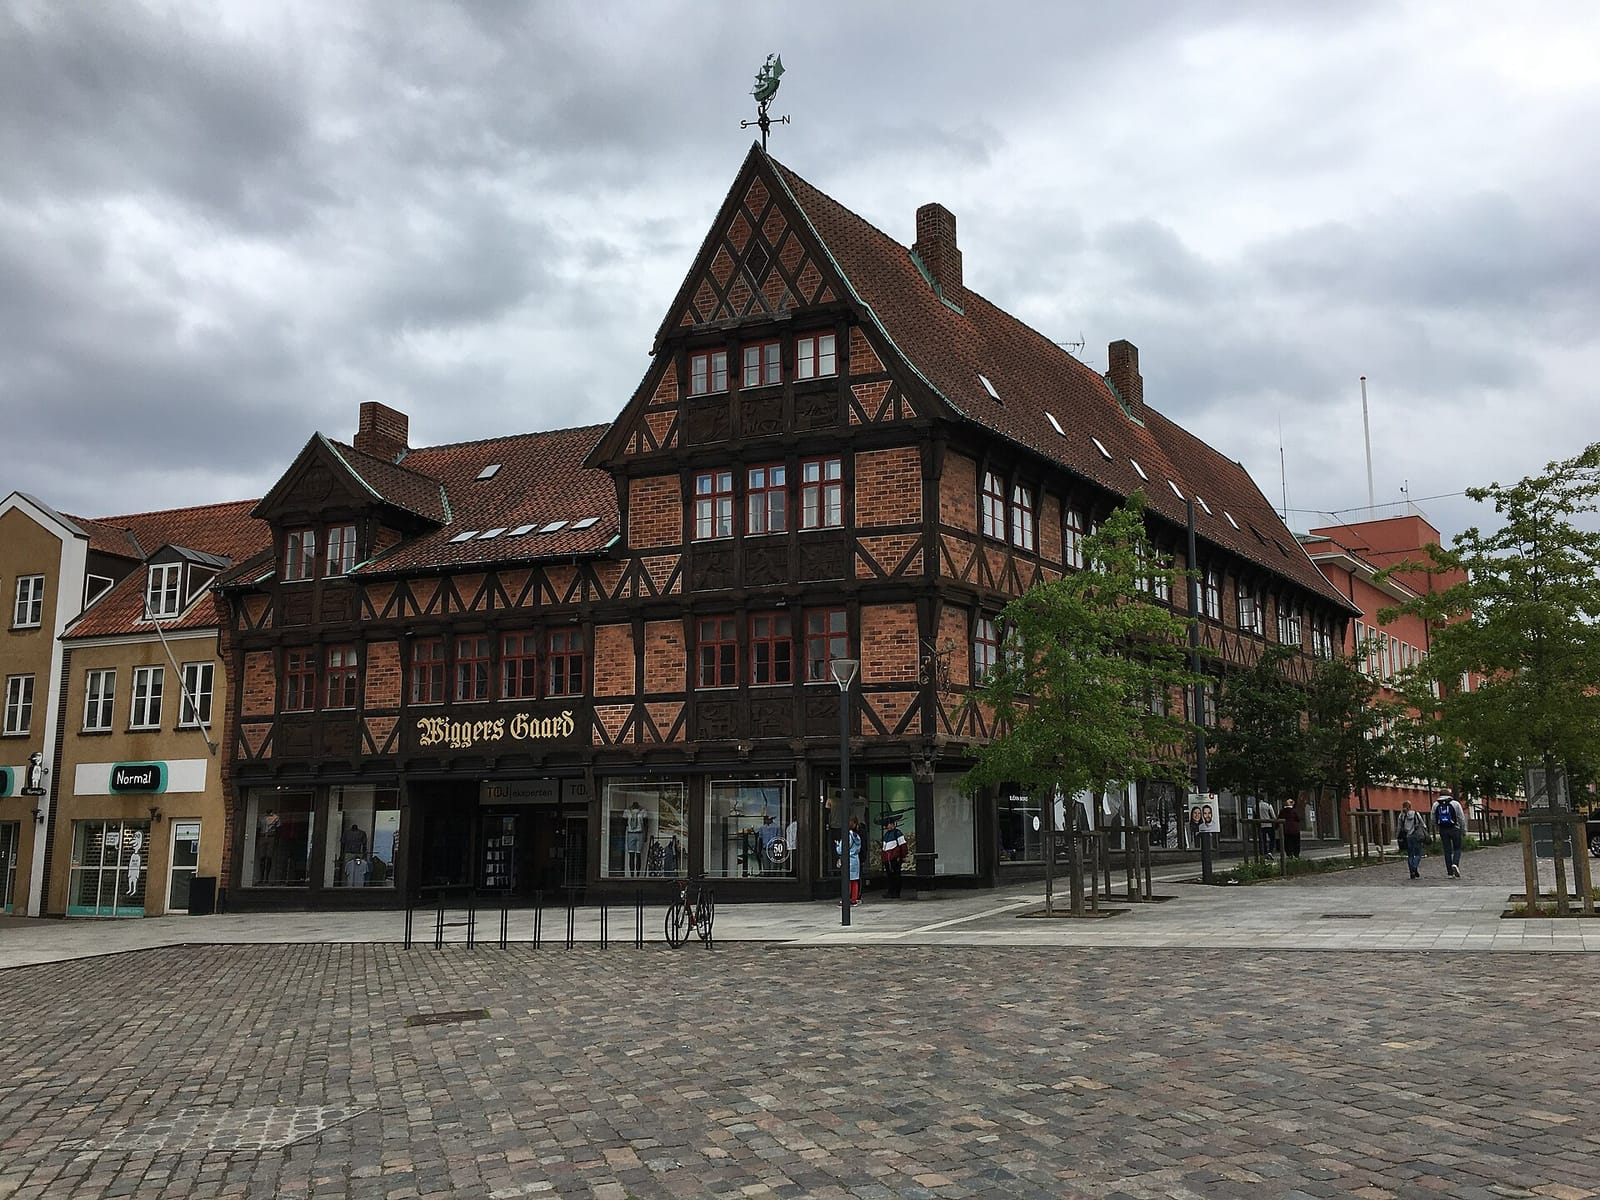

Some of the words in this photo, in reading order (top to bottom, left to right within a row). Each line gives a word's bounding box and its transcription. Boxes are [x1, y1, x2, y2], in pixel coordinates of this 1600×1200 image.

[416, 716, 506, 749] Wiggers
[510, 710, 575, 740] Gaard
[116, 769, 152, 785] Normal
